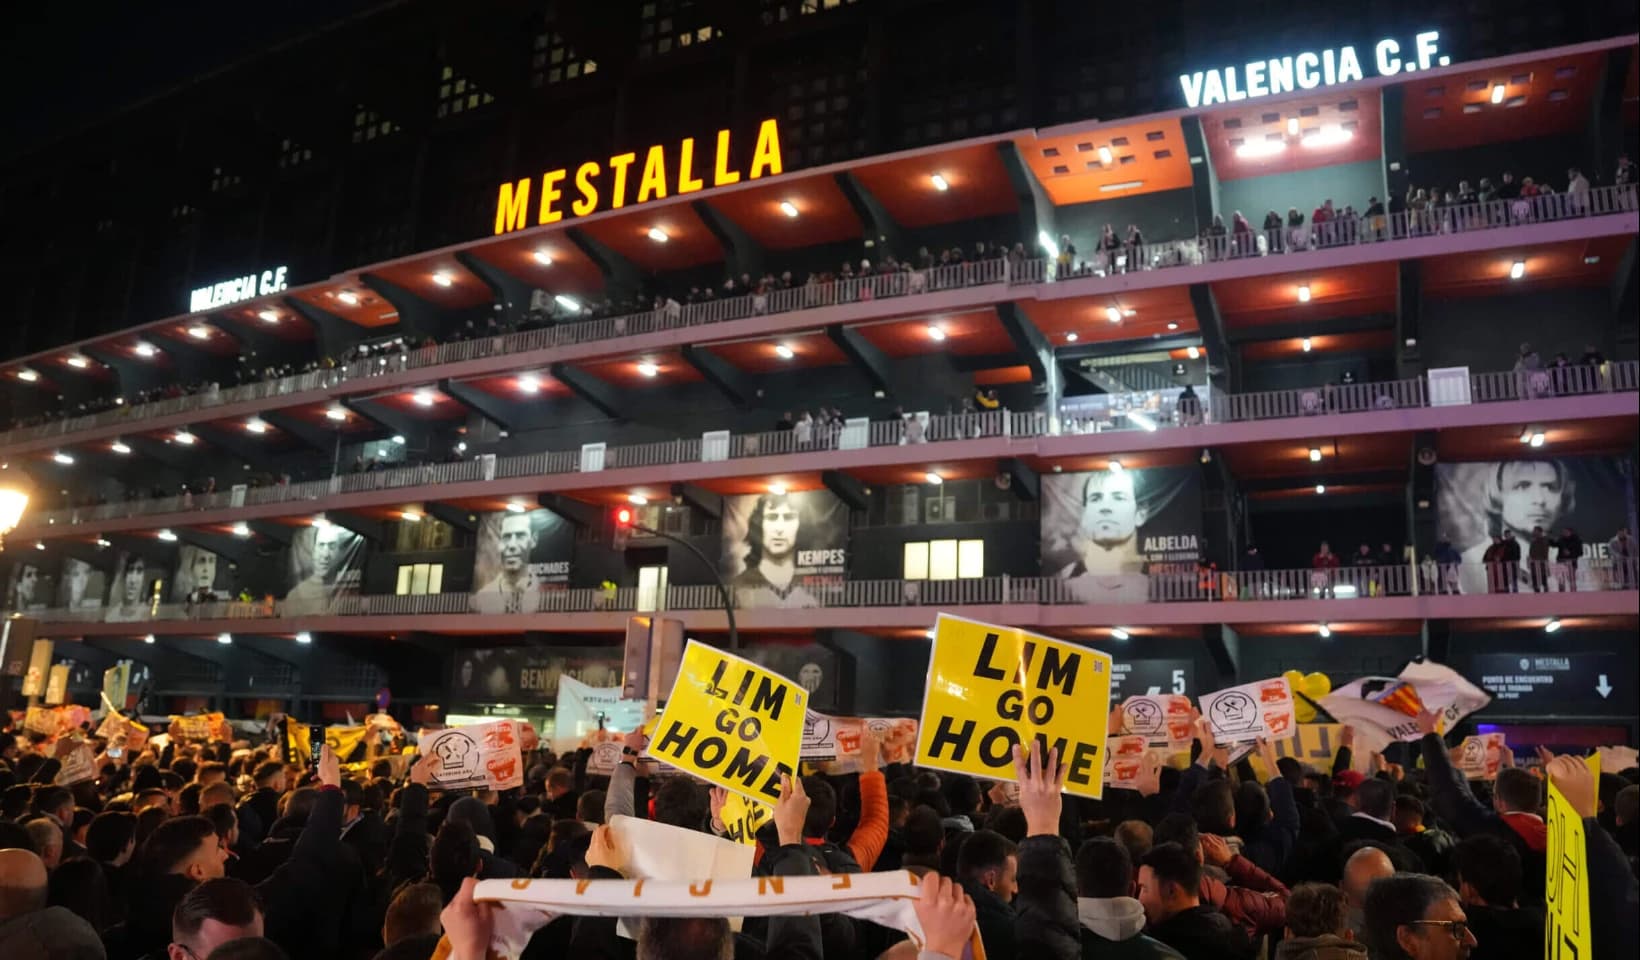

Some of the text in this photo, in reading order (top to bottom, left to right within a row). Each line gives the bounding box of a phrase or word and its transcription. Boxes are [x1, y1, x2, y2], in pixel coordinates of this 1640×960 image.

[1179, 31, 1451, 107] VALENCIA C.F.
[494, 118, 783, 235] MESTALLA
[190, 266, 288, 312] VALENCIA C.F.
[797, 549, 845, 566] KEMPES
[1143, 535, 1199, 551] ALBELDA
[973, 633, 1081, 696] LIM
[1172, 669, 1186, 694] 5
[704, 659, 788, 721] LIM
[996, 689, 1054, 726] GO
[1445, 703, 1460, 721] CF
[716, 708, 762, 741] GO
[657, 720, 793, 798] HOME
[927, 715, 1098, 785] HOME
